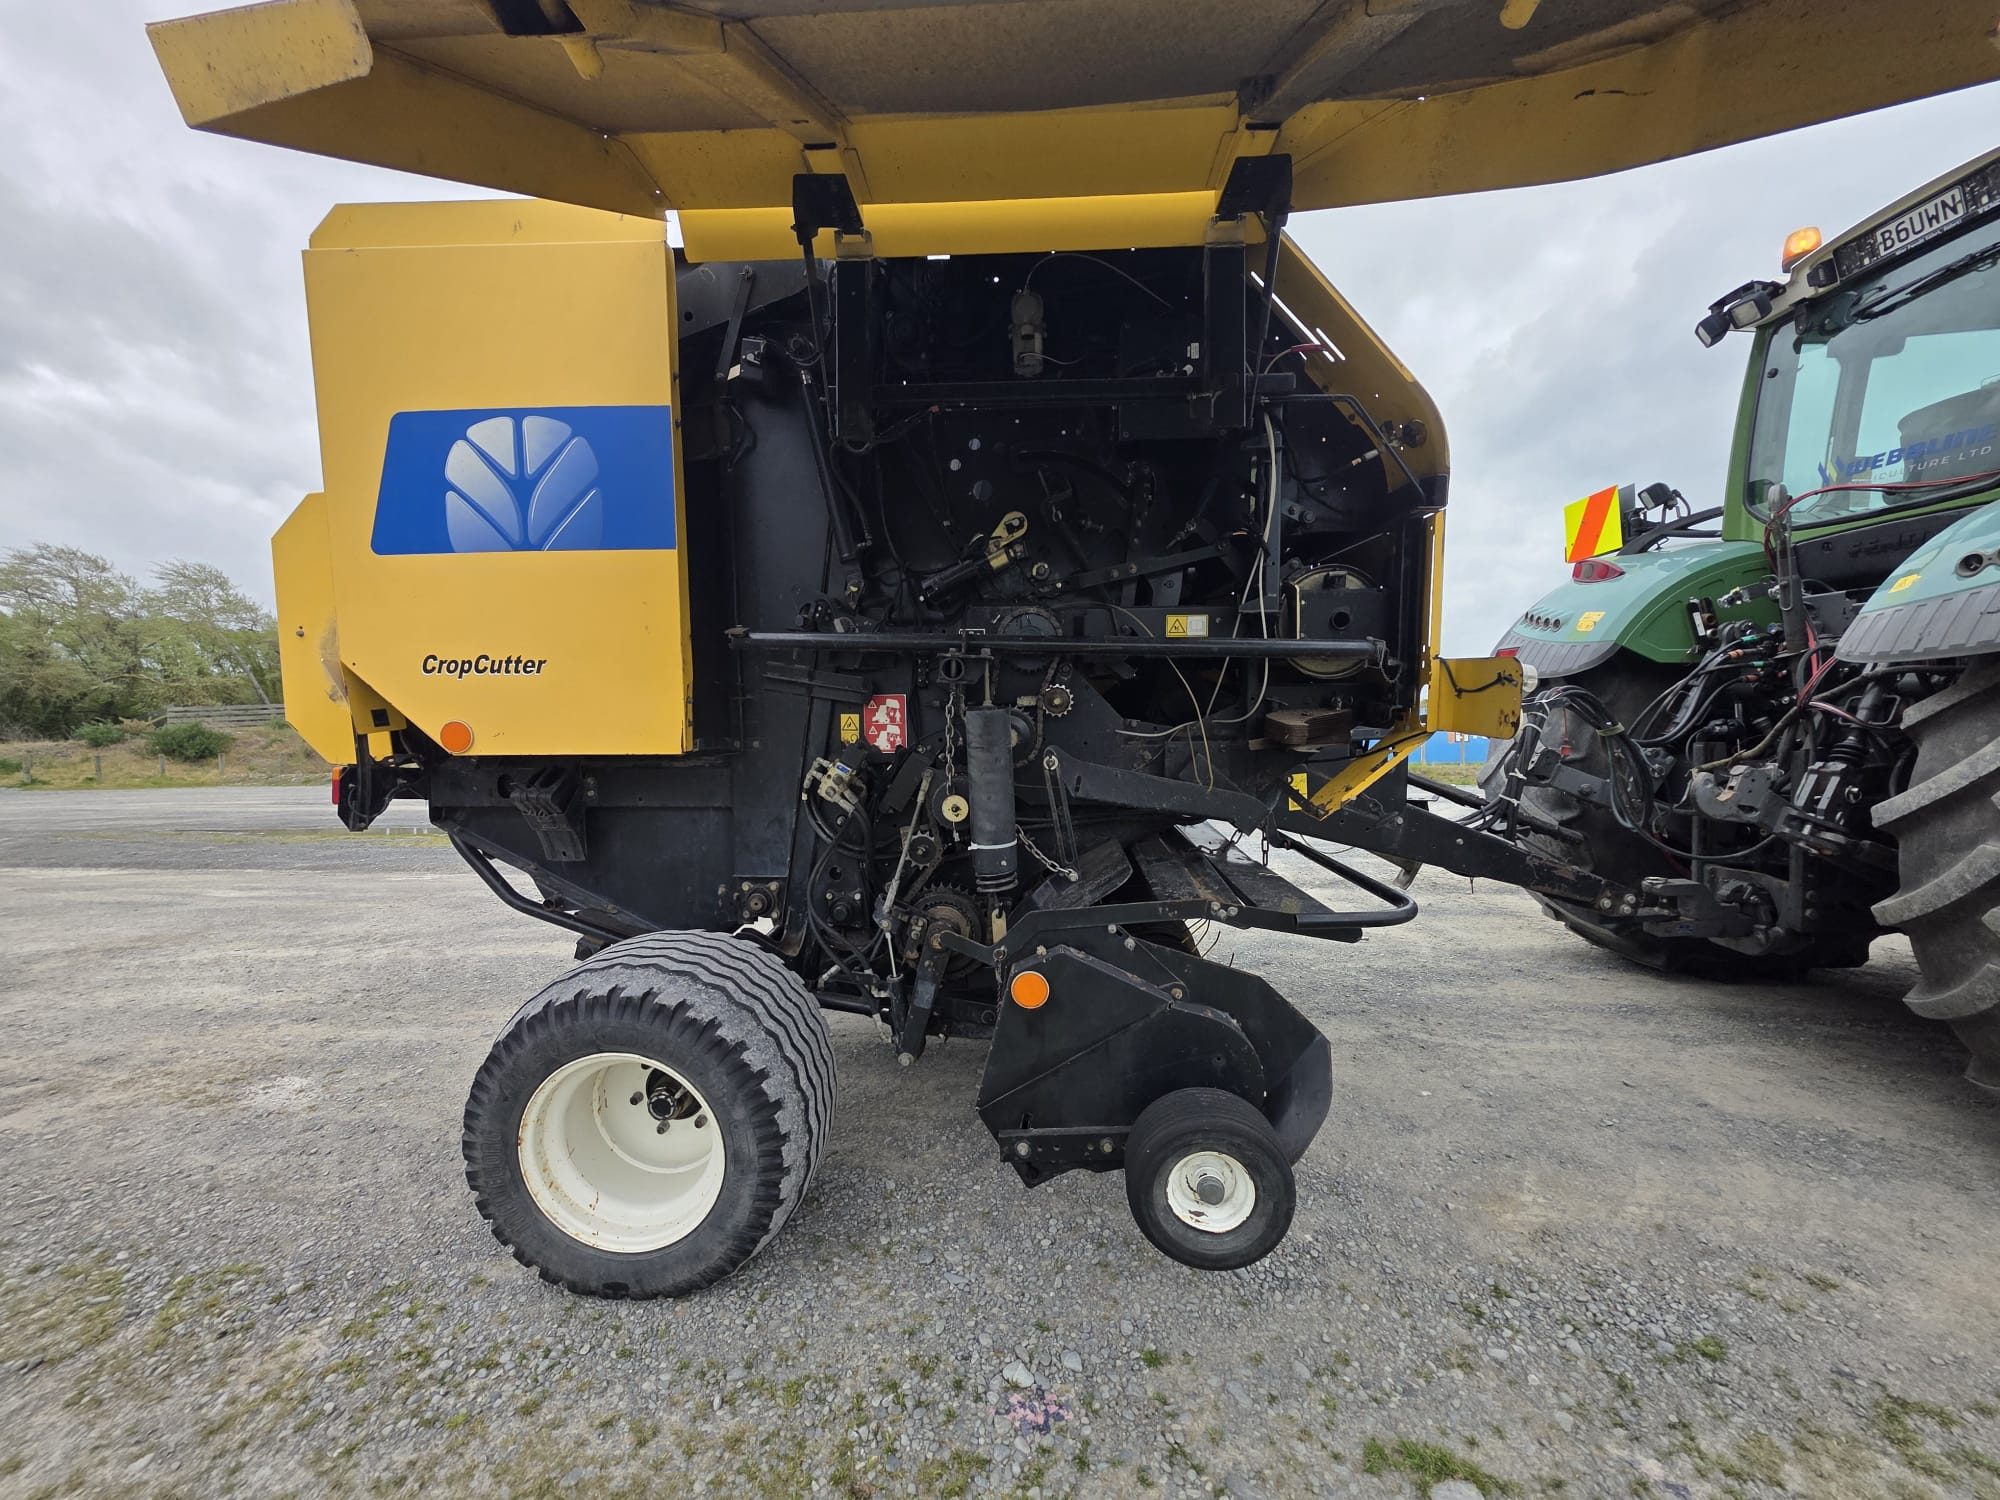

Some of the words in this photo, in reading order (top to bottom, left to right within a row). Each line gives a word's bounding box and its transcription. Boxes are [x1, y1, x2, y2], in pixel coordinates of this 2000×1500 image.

[1879, 193, 1960, 253] B6UWN
[1957, 445, 1993, 462] LTD
[421, 653, 547, 680] CropCutter
